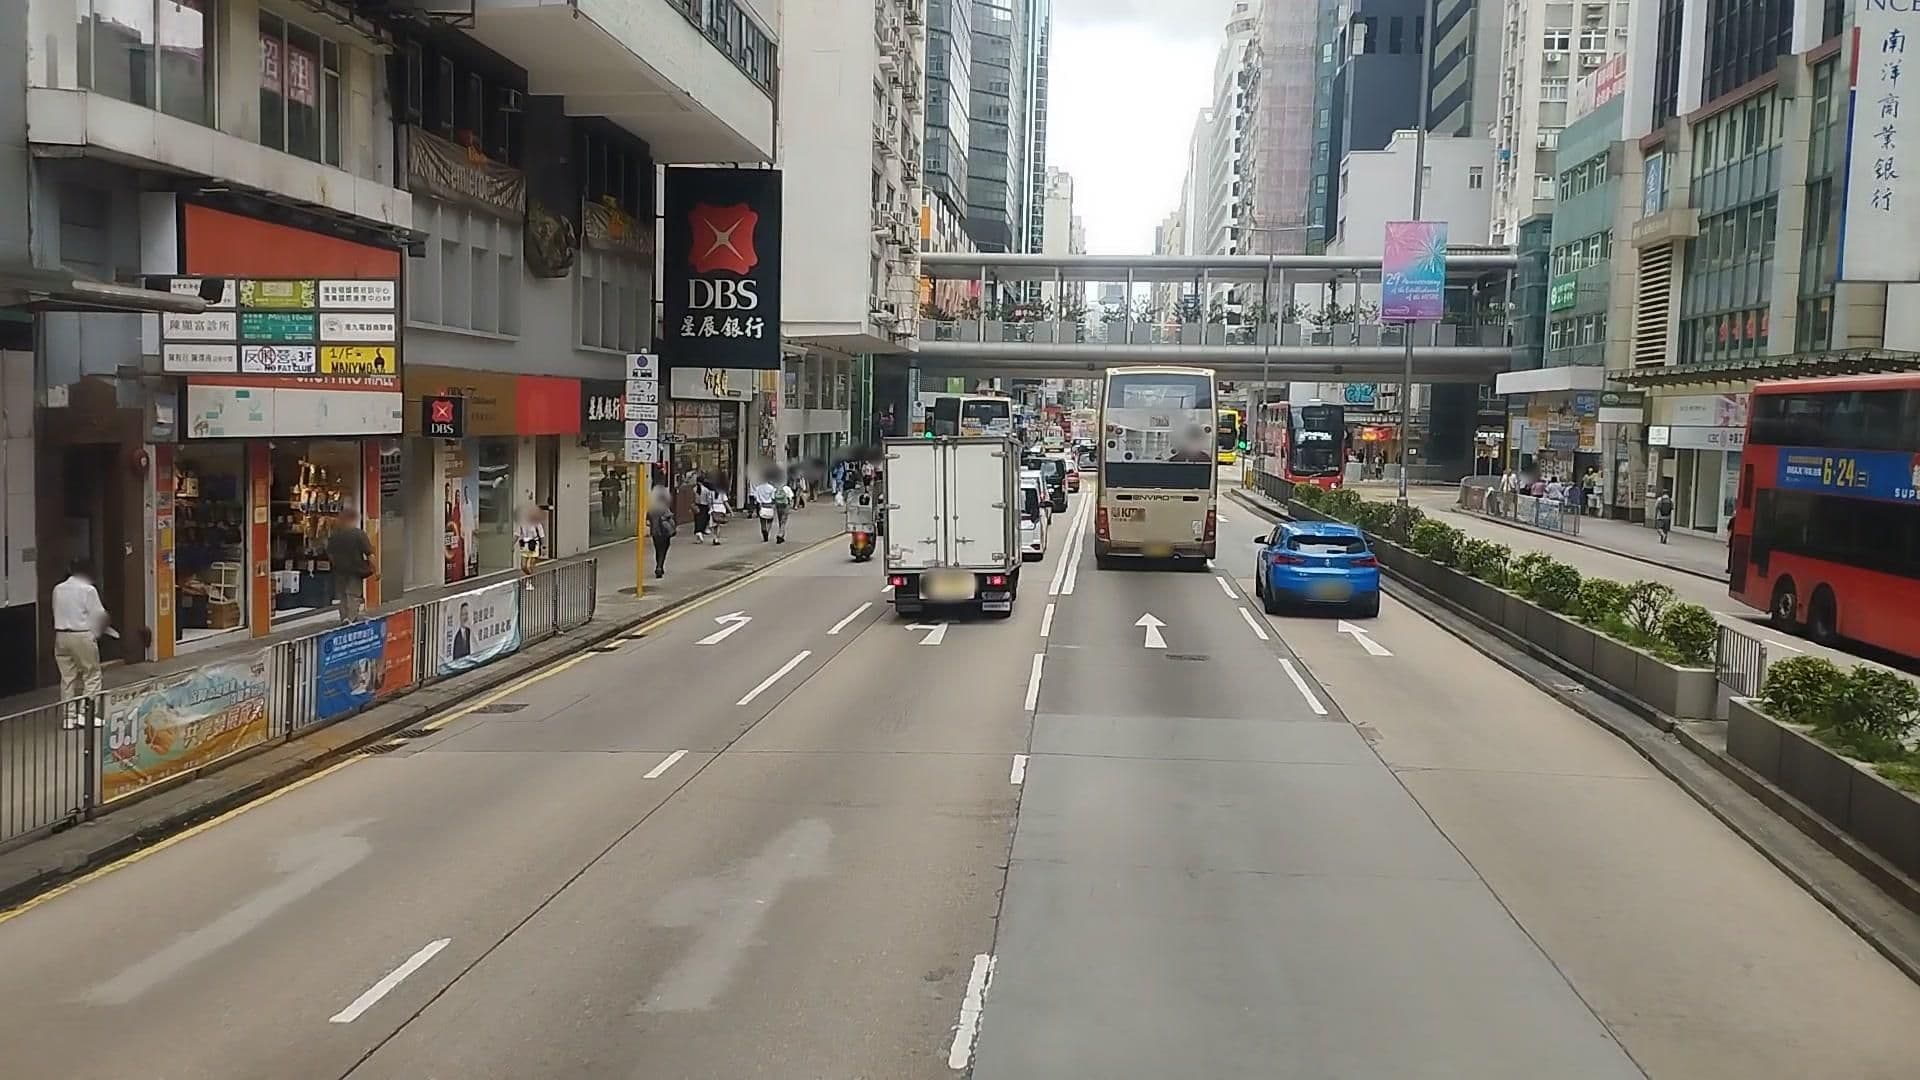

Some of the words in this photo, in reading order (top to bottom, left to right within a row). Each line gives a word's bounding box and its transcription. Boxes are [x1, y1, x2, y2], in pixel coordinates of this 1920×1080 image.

[258, 38, 310, 91] 招租
[1870, 27, 1906, 213] 南洋商業銀行
[687, 279, 758, 310] DBS
[680, 315, 765, 339] 星展銀行
[298, 350, 313, 363] 3/F
[264, 364, 277, 372] NO
[277, 364, 291, 372] FAT
[646, 394, 656, 402] 12
[431, 423, 454, 434] DBS
